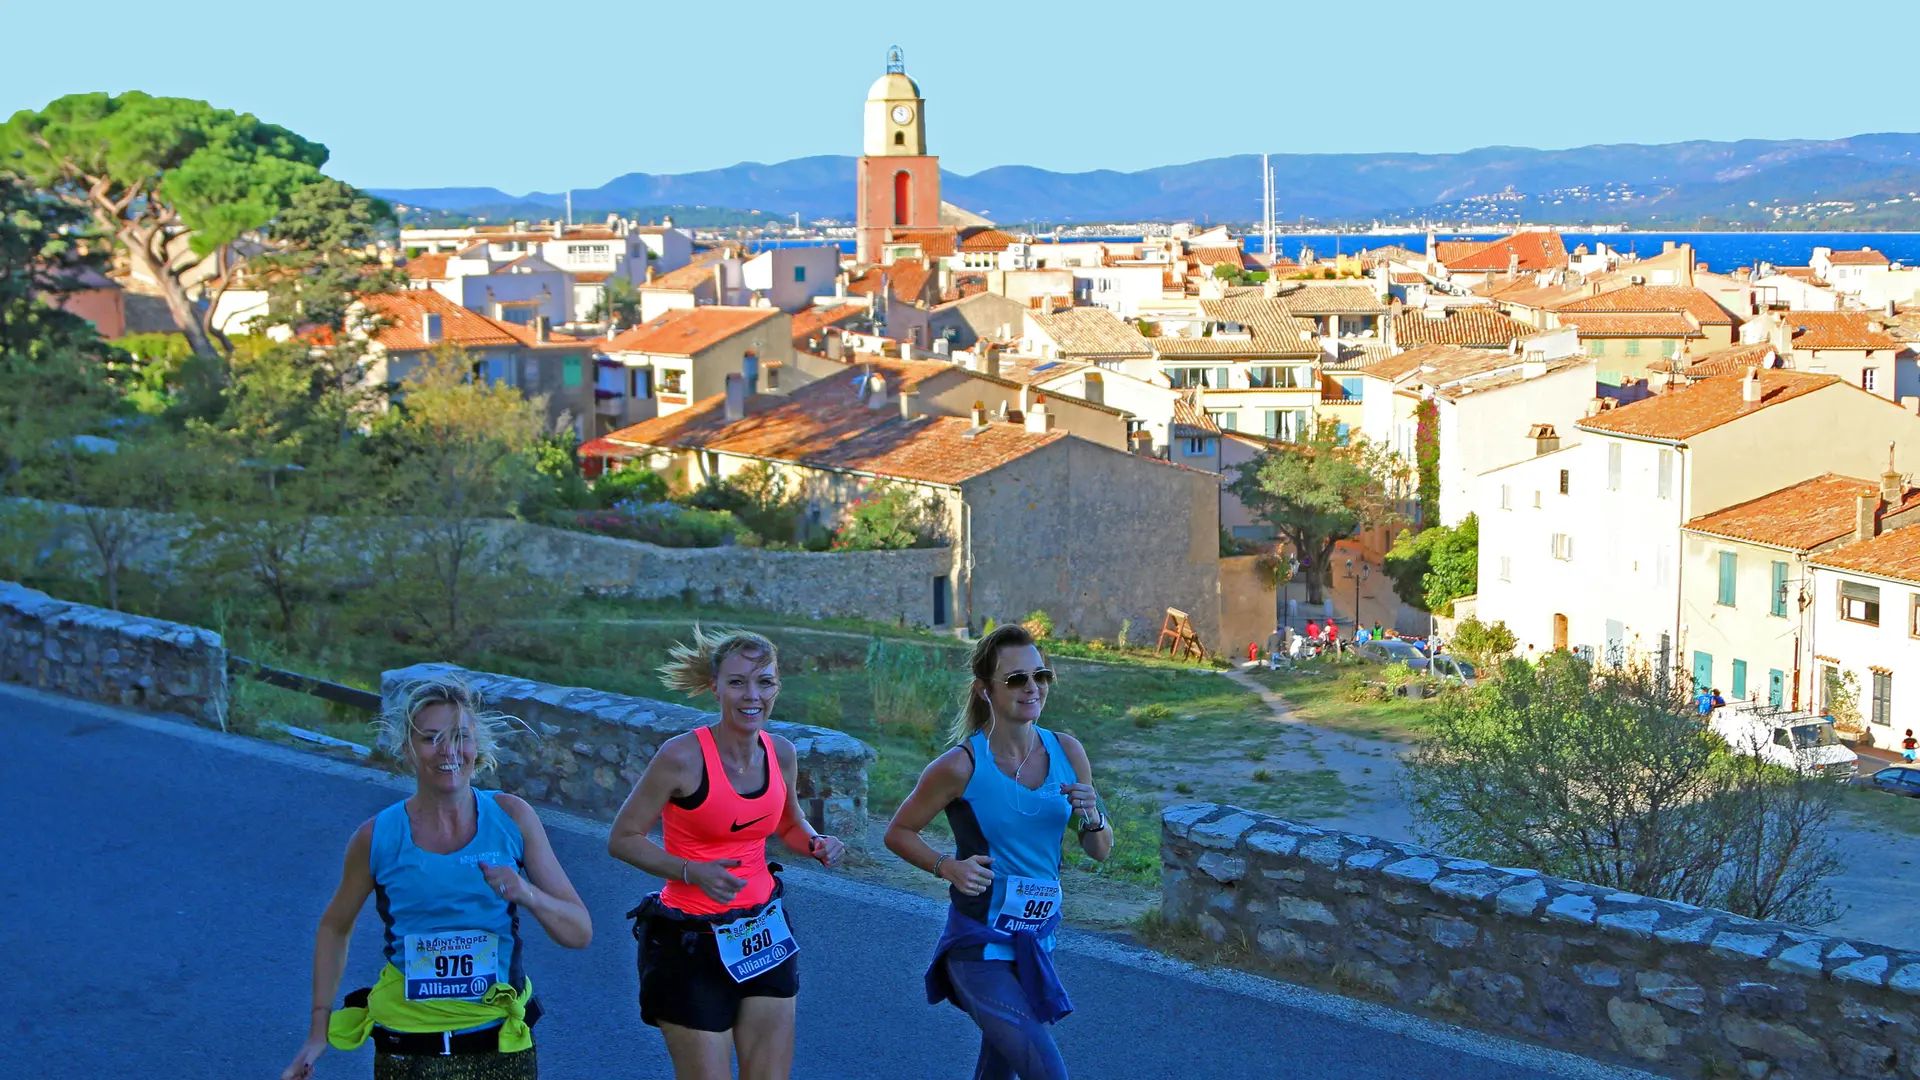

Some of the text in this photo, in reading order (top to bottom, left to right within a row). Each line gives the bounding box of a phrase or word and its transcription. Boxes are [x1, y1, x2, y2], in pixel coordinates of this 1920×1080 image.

[1024, 884, 1059, 893] SAINT-TRO
[1023, 899, 1054, 918] 949
[1004, 918, 1040, 932] Allianz
[425, 935, 488, 947] SAINT-TROPEZ
[741, 928, 773, 957] 830
[434, 953, 474, 978] 976
[736, 953, 773, 976] Allianz
[418, 982, 468, 996] Allianz
